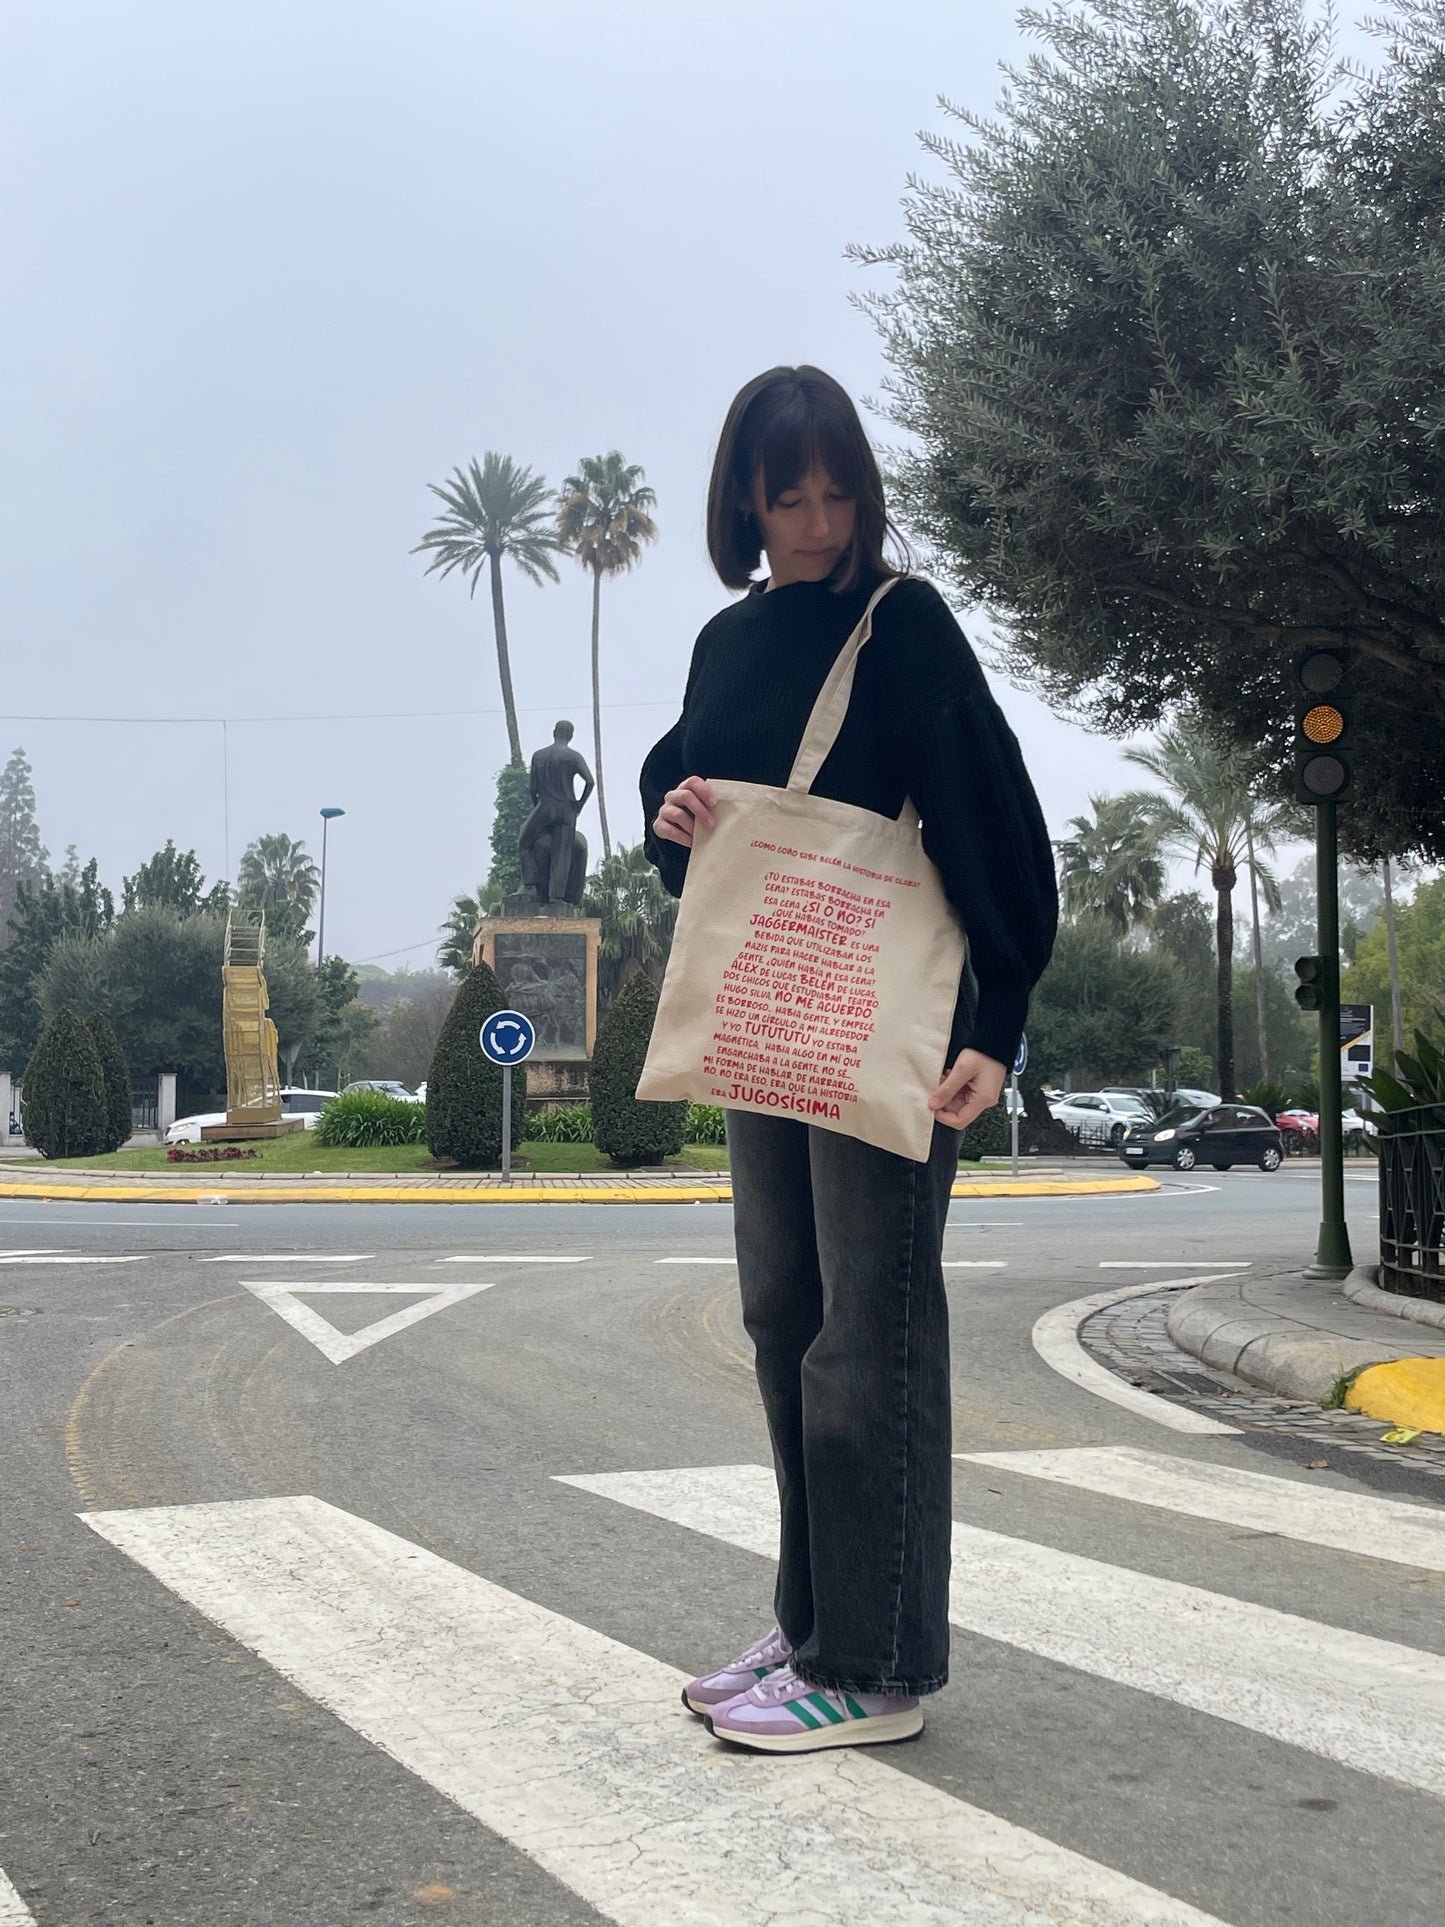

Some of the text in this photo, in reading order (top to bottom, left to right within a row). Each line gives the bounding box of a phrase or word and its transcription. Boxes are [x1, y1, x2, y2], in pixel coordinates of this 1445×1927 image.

[800, 852, 817, 861] SABE
[843, 862, 851, 871] LA
[853, 866, 882, 880] HISTORIA
[765, 883, 885, 918] CENA? ESTABAS BORRACHA EN
[782, 875, 816, 888] ESTABAS
[818, 881, 861, 902] BORRACHA
[863, 897, 874, 905] EN
[877, 900, 891, 908] ESA
[764, 896, 778, 906] ESA
[780, 900, 800, 909] CENA
[824, 905, 834, 917] O
[837, 910, 862, 927] NO?
[750, 914, 880, 953] JAGGERMAISTER ES UNA
[827, 920, 866, 936] TOMADO?
[745, 941, 768, 952] NAZIS
[770, 945, 790, 956] PARA
[793, 950, 819, 963] HACER
[821, 958, 854, 971] HABLAR
[864, 967, 875, 976] LA
[754, 931, 872, 963] BEBIDA QUE UTILIZABAN LOS
[738, 952, 764, 964] GENTE
[834, 974, 848, 982] ESA
[851, 976, 875, 986] CENA?
[760, 968, 770, 976] DE
[772, 971, 797, 982] LUCAS
[837, 985, 848, 994] DE
[716, 994, 725, 1003] ES
[723, 971, 740, 981] DOS
[742, 975, 770, 987] CHICOS
[772, 980, 789, 991] QUE
[792, 984, 842, 1002] ESTUDIABAN
[724, 983, 748, 994] HUGO
[775, 991, 792, 1002] NO
[796, 996, 814, 1009] ME
[716, 1006, 724, 1014] SE
[726, 1008, 746, 1019] HIZO
[748, 1013, 760, 1021] UN
[799, 1023, 804, 1031] A
[819, 1027, 869, 1042] ALREDEDOR
[722, 1021, 858, 1054] Y YO TUTUTUTU YO ESTABA
[716, 1057, 744, 1070] FORMA
[747, 1063, 757, 1073] DE
[796, 1073, 807, 1082] DE
[717, 1046, 770, 1064] ENGANCHABA
[780, 1058, 790, 1068] LA
[822, 1066, 835, 1076] NO
[792, 1048, 814, 1059] ALGO
[816, 1052, 827, 1061] EN
[843, 1057, 861, 1068] QUE
[711, 1084, 840, 1120] ERA JUGOSÍSIMA
[720, 1069, 732, 1078] NO
[734, 1072, 748, 1082] ERA
[770, 1079, 786, 1090] ERA
[788, 1082, 806, 1093] QUE
[808, 1087, 817, 1095] LA
[820, 1089, 858, 1104] HISTORIA
